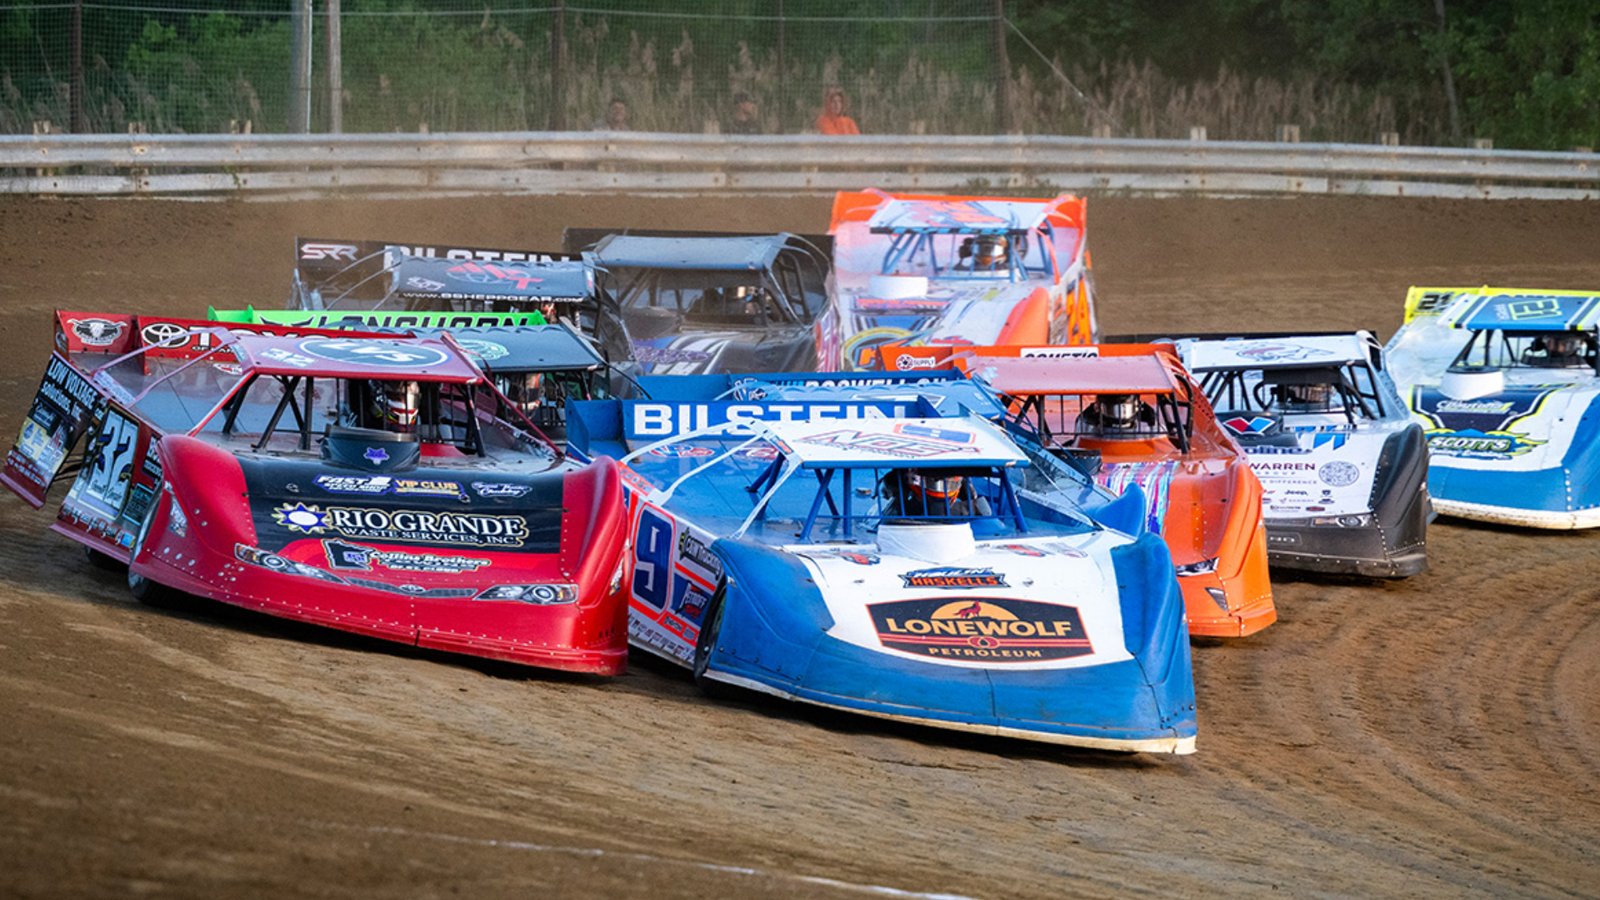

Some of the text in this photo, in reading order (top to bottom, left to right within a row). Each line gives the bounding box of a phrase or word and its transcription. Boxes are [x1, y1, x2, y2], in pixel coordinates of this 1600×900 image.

[48, 357, 69, 384] LOW
[64, 371, 98, 410] VOLTAGE
[86, 410, 138, 509] 32
[395, 480, 459, 490] VIP CLUB
[332, 509, 525, 538] RIO GRANDE
[343, 527, 519, 546] WASTE SERVICES, INC.
[425, 554, 489, 566] Brothers
[632, 509, 672, 610] 9
[911, 576, 998, 586] HASKELLS
[886, 617, 1071, 637] LONEWOLF
[928, 646, 1042, 658] PETROLEUM
